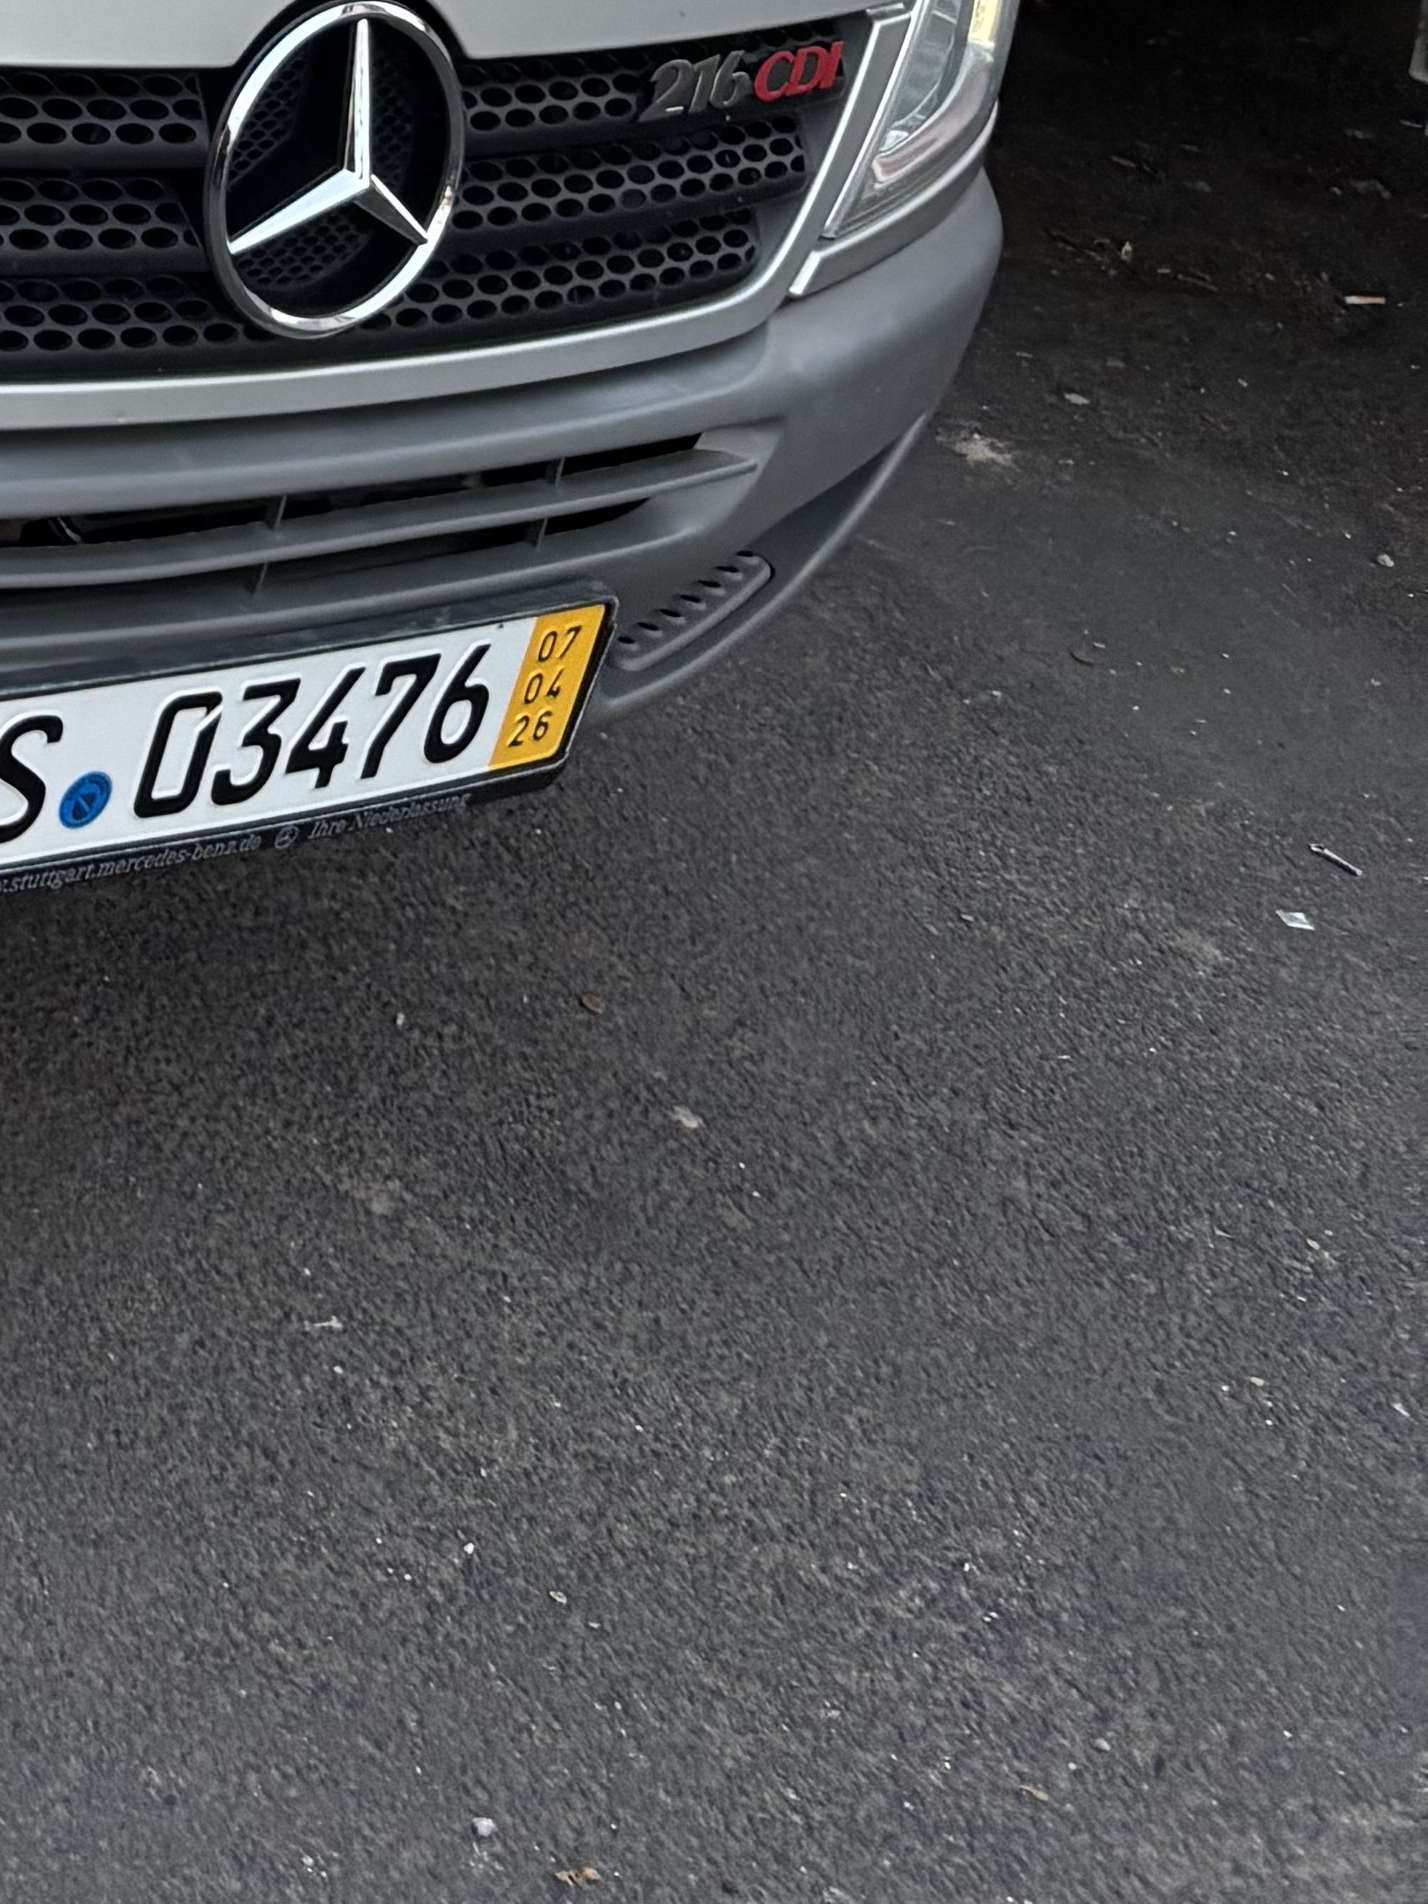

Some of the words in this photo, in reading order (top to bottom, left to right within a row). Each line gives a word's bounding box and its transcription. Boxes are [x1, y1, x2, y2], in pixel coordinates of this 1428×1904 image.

[639, 49, 753, 123] 216
[753, 40, 847, 103] CDI
[536, 625, 582, 662] 07
[523, 666, 564, 706] 04
[133, 642, 491, 819] 03476
[505, 710, 552, 750] 26
[308, 816, 346, 842] Ihre
[348, 793, 472, 832] Niederlassung
